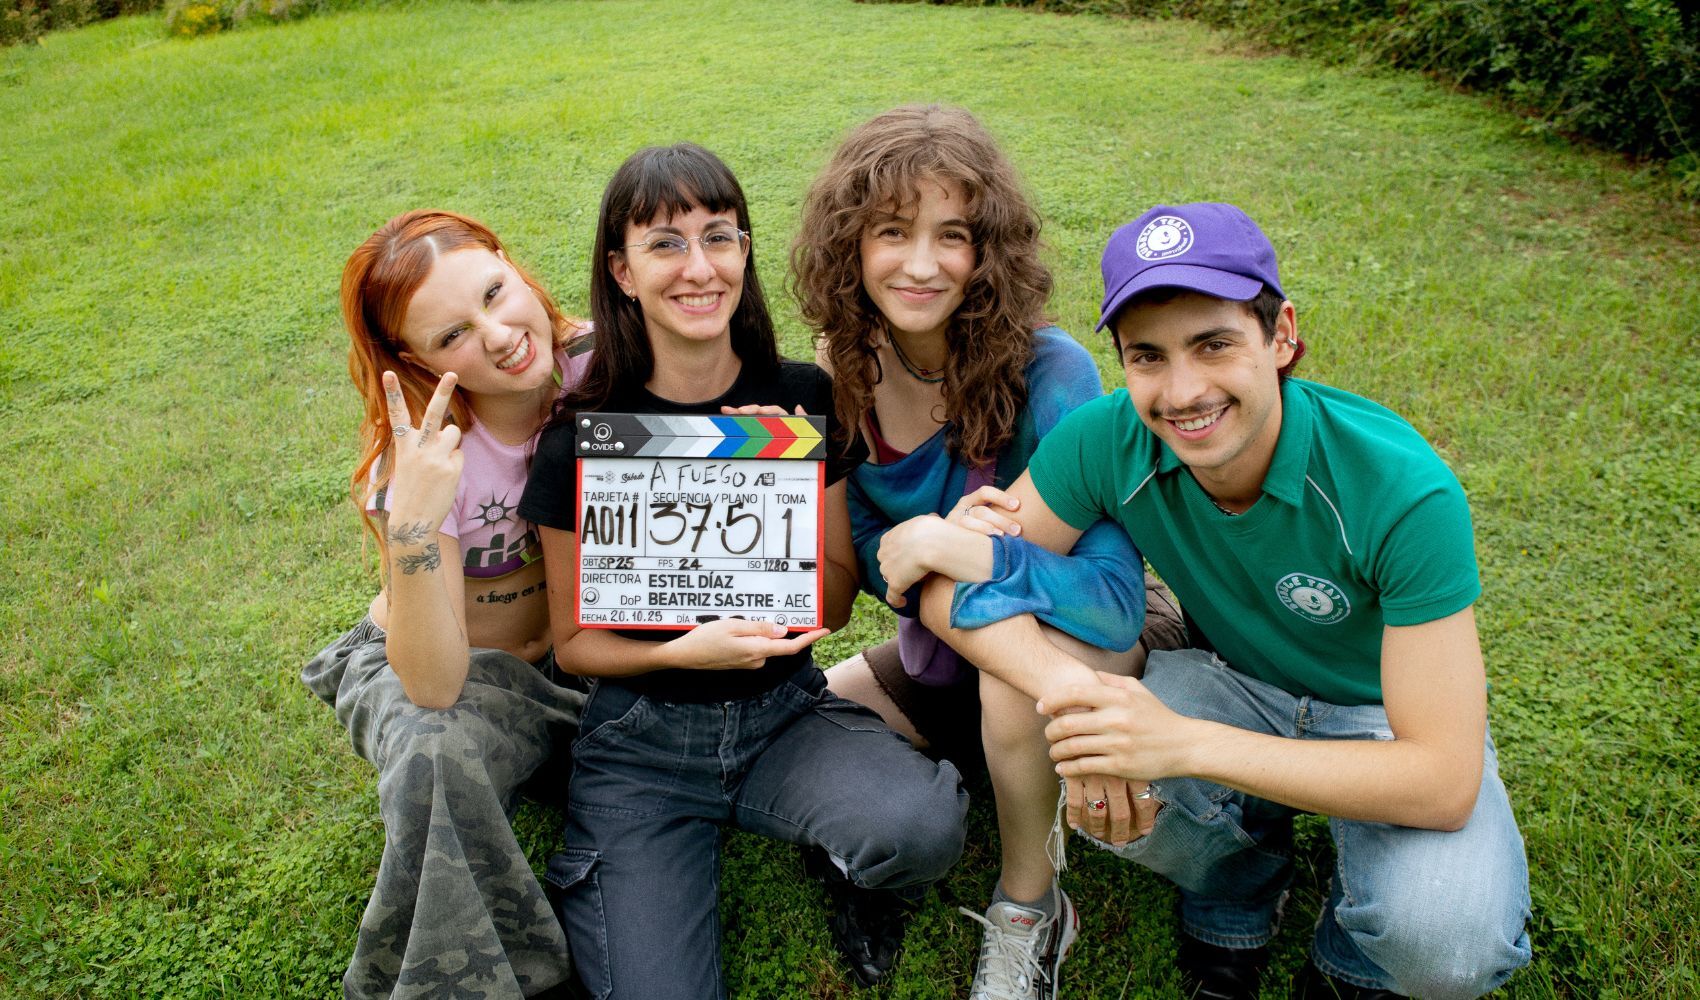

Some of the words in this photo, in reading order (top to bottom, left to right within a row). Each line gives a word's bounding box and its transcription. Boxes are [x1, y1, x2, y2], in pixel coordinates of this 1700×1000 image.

[591, 443, 614, 451] OVIDE
[650, 461, 666, 491] A
[677, 463, 746, 490] FUEGO
[583, 491, 630, 502] TARJETA
[632, 492, 639, 502] #
[653, 492, 711, 503] SECUENCIA
[721, 493, 758, 504] PLANO
[775, 493, 807, 504] TOMA
[781, 507, 793, 558] 1
[598, 557, 635, 570] SP25
[658, 559, 674, 568] FPS
[678, 558, 703, 571] 24
[747, 560, 761, 569] ISO
[764, 559, 789, 572] 1280
[582, 573, 642, 584] DIRECTORA
[648, 574, 695, 588] ESTEL
[699, 571, 734, 589] DÍAZ
[486, 590, 519, 604] fuego
[521, 585, 535, 597] en
[620, 595, 641, 606] DoP
[648, 592, 711, 606] BEATRIZ
[714, 593, 774, 608] SASTRE
[784, 594, 812, 608] AEC
[581, 613, 608, 622] FECHA
[610, 609, 663, 623] 20.10.25
[676, 614, 690, 624] DÍA
[790, 616, 816, 625] OVIDE
